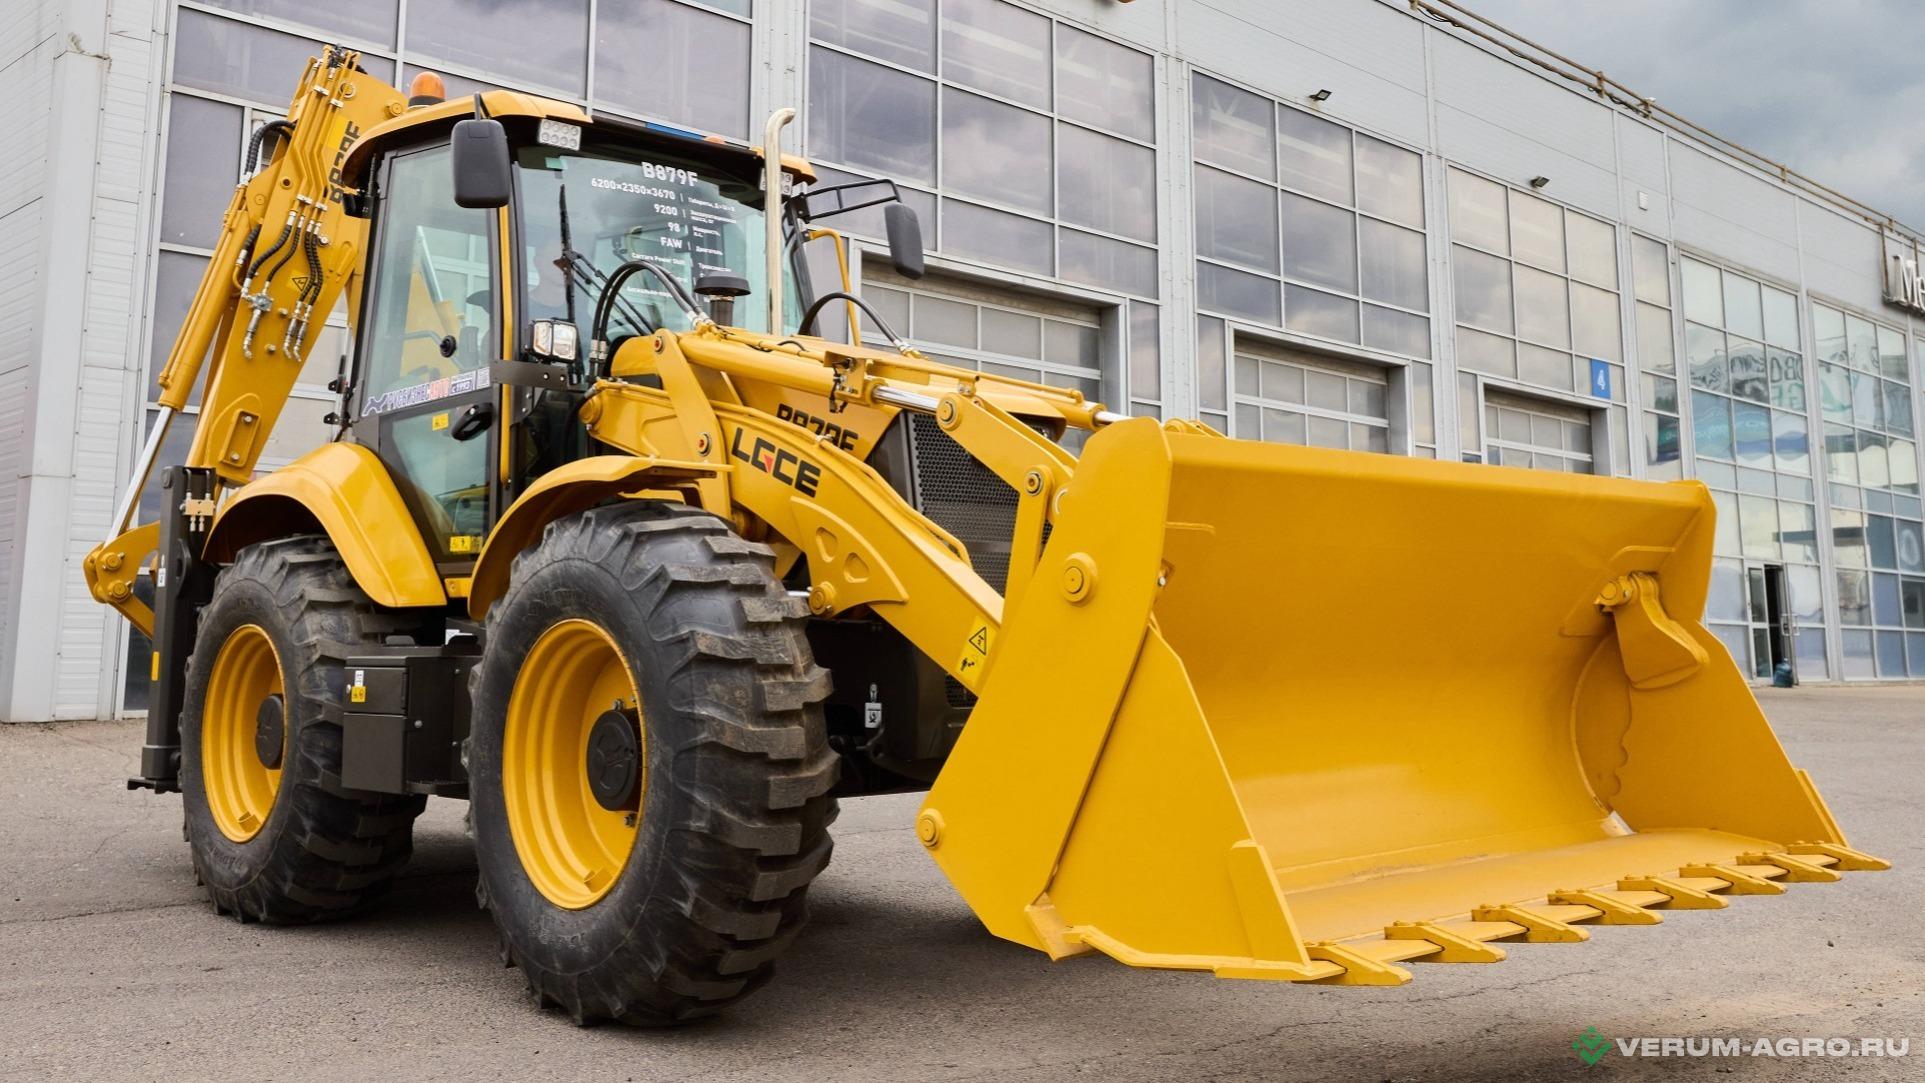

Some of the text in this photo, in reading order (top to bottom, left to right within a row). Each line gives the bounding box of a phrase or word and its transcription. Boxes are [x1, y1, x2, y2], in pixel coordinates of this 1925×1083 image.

[642, 162, 698, 186] B879F
[654, 203, 678, 216] 9200
[668, 222, 680, 232] 98
[660, 236, 682, 249] FAW
[1597, 369, 1606, 390] 4
[731, 427, 821, 498] LGCE
